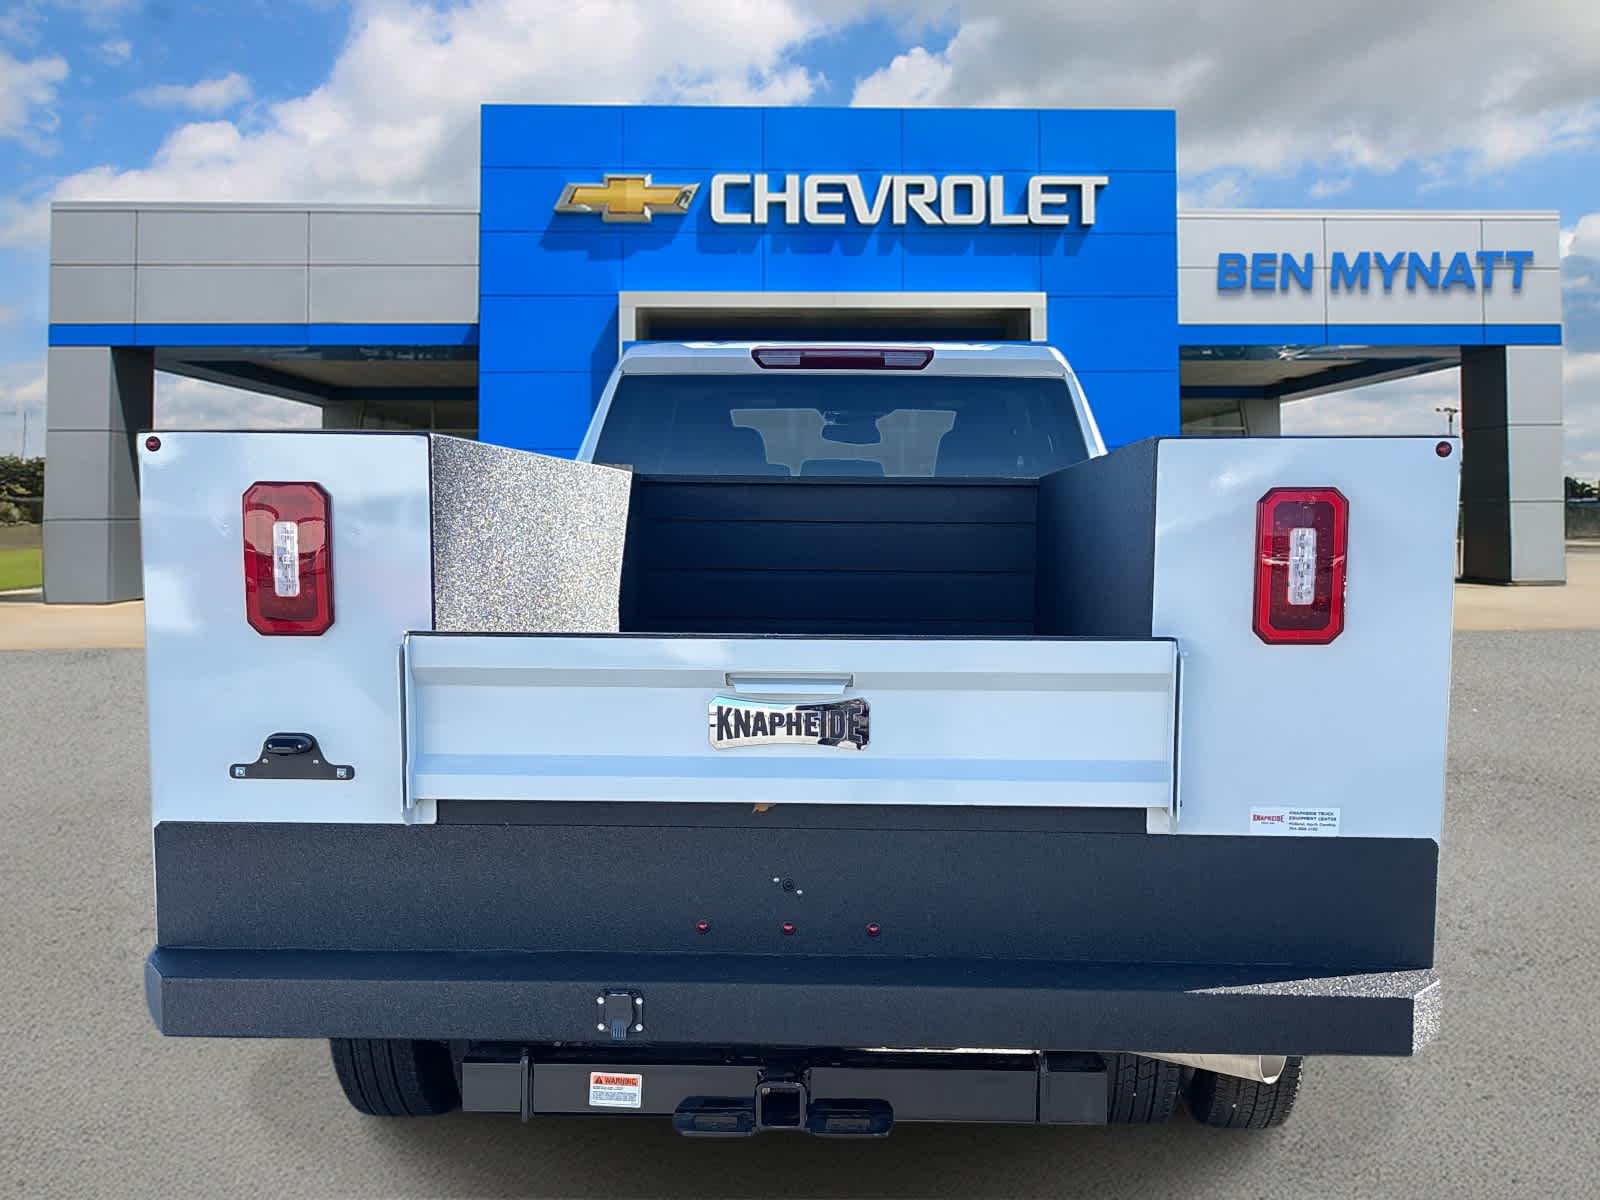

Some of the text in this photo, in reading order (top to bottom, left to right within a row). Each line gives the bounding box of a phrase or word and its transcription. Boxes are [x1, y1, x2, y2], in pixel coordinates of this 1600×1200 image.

[711, 173, 1109, 225] CHEVROLET
[1217, 250, 1534, 290] BEN MYNATT
[716, 704, 863, 744] KNAPHEIDE
[604, 1075, 637, 1086] WARNING
